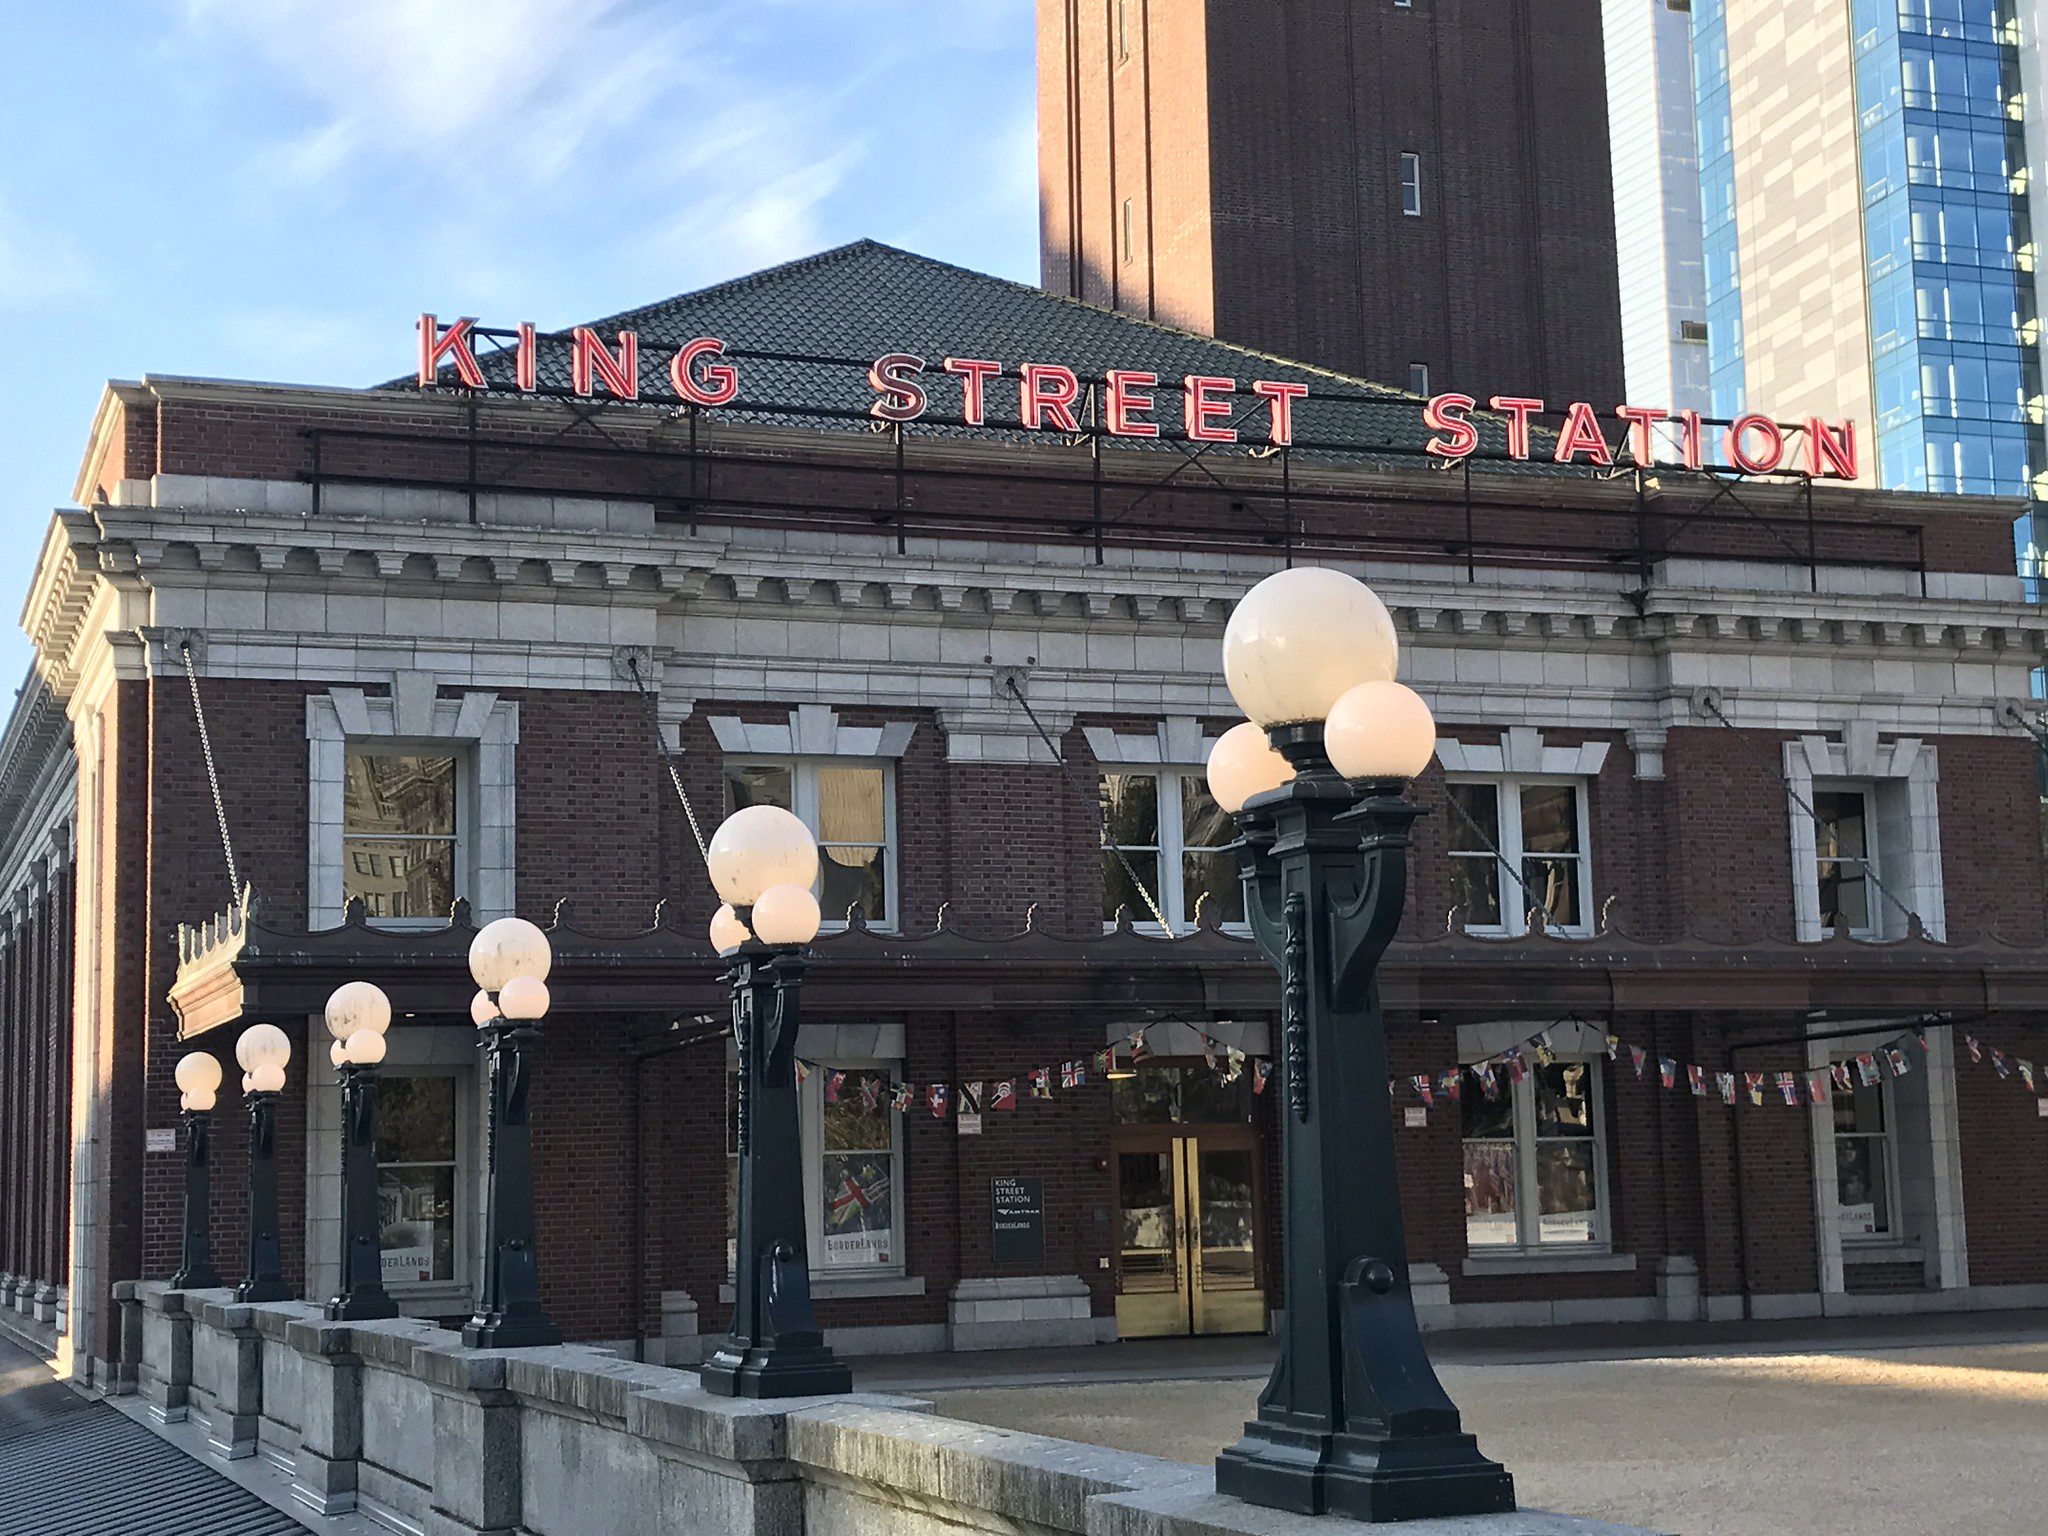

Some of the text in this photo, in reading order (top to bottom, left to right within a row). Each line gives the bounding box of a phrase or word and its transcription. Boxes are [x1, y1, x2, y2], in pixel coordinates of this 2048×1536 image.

[416, 313, 1859, 481] KING STREET STATION
[995, 1179, 1016, 1187] KING
[995, 1187, 1025, 1195] STREET
[995, 1195, 1031, 1204] STATION
[381, 1256, 430, 1268] DERLANDS
